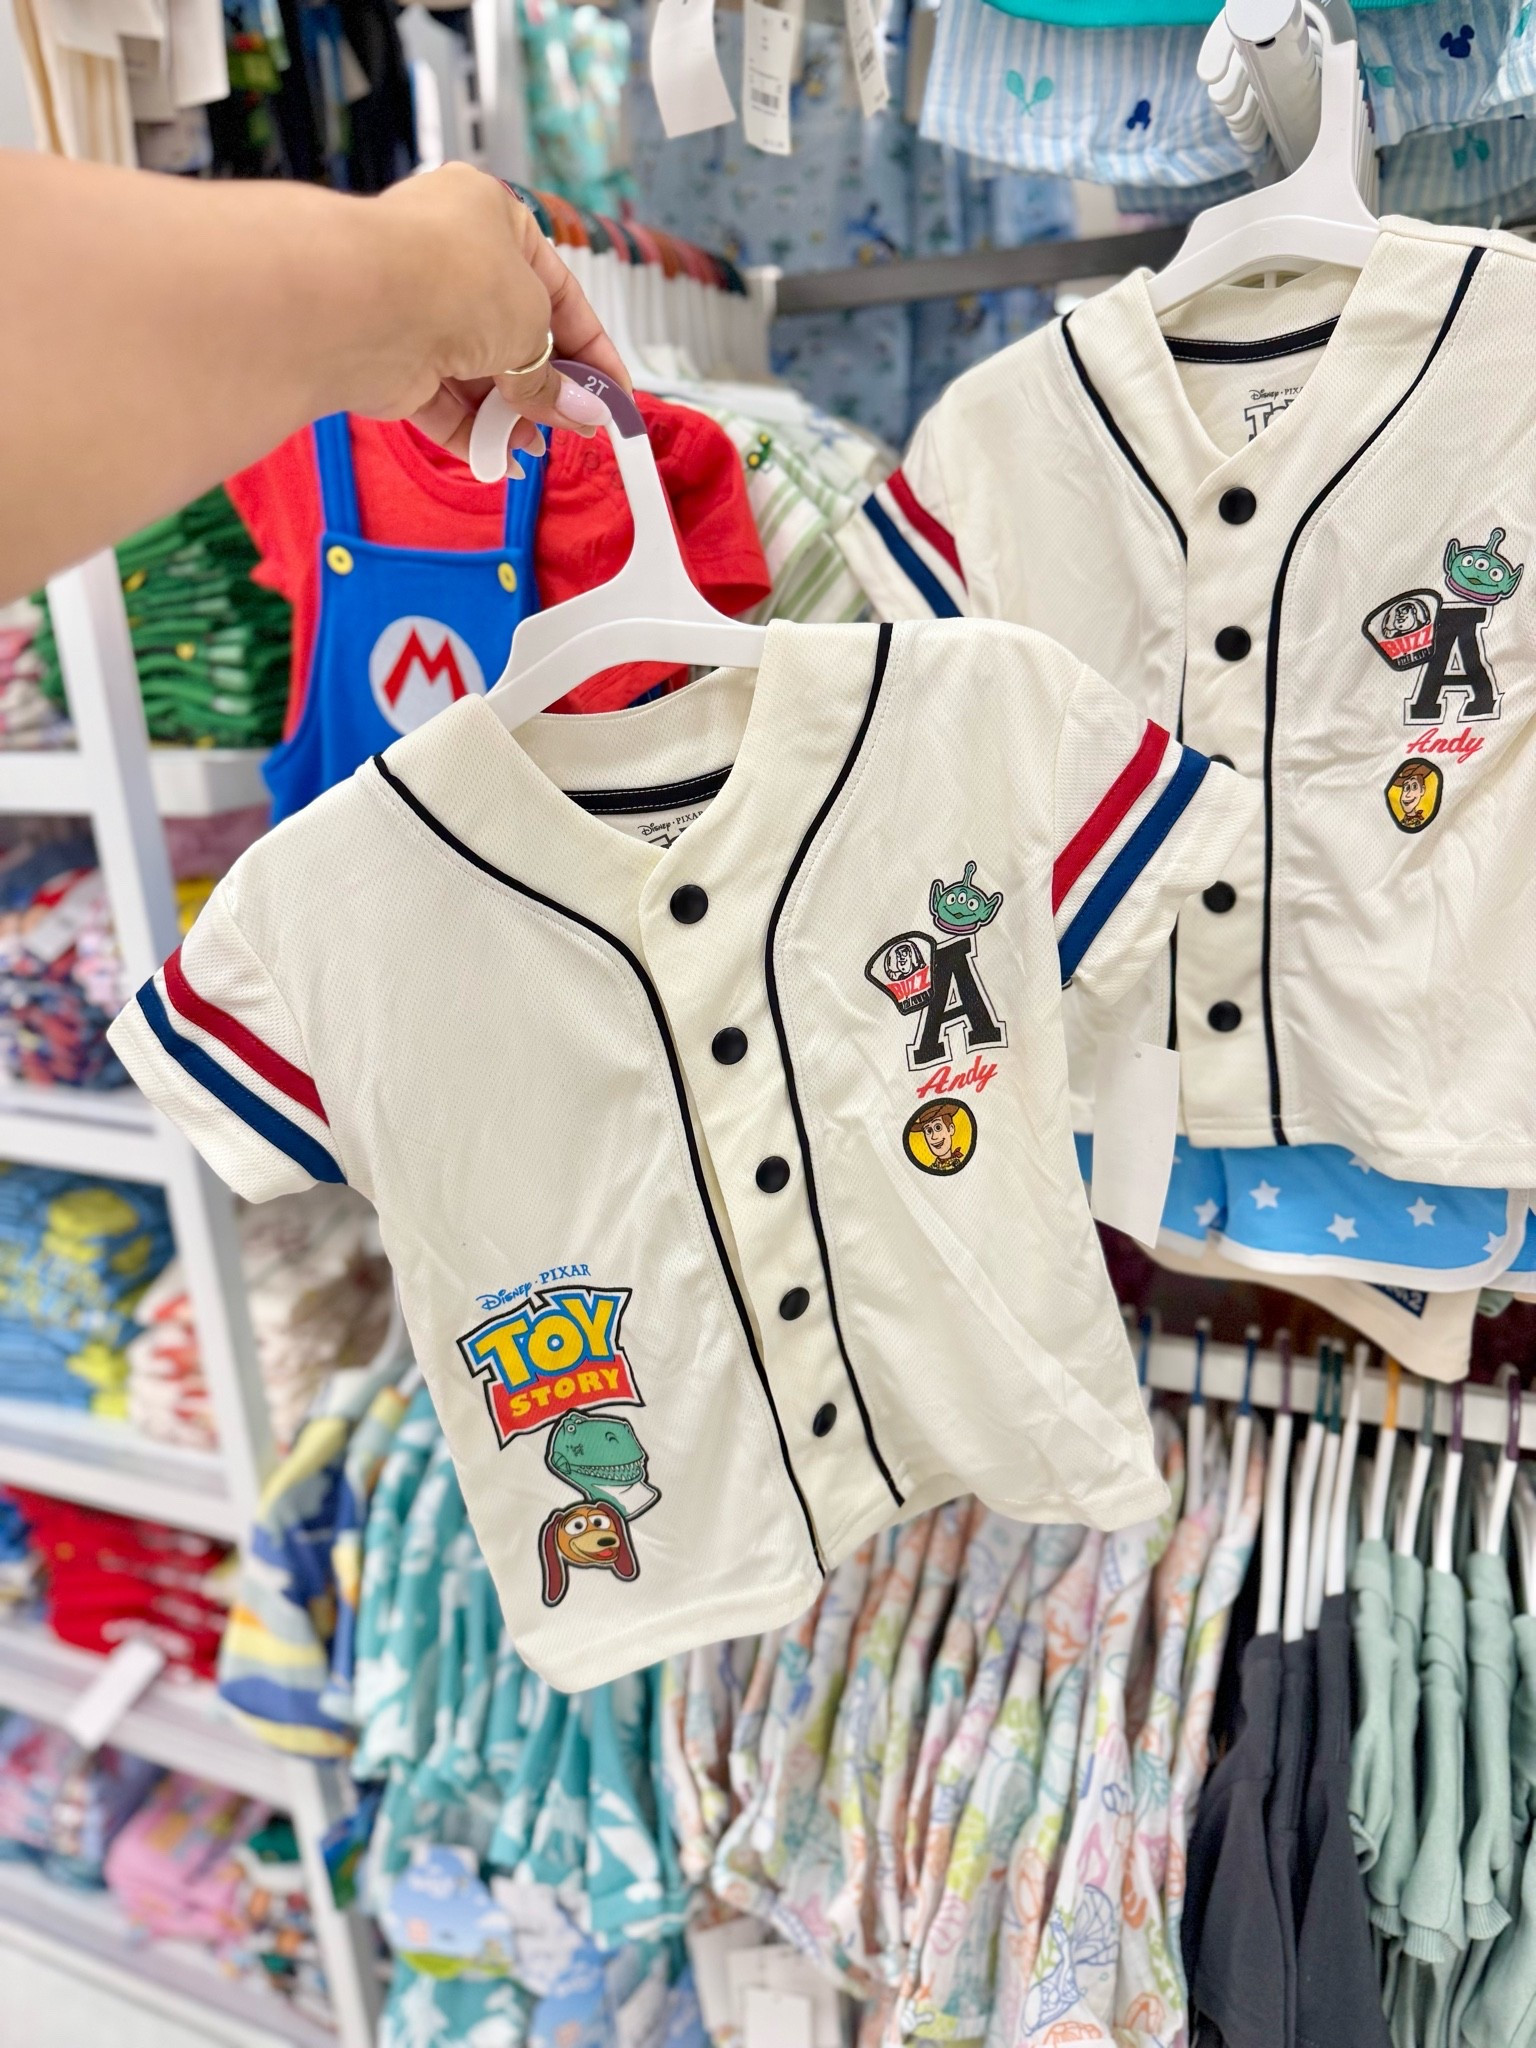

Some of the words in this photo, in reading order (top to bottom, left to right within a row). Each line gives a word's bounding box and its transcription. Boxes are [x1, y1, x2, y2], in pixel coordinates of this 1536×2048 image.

[583, 375, 610, 397] 2T
[1248, 388, 1280, 401] Disney
[1379, 622, 1433, 658] BUZZ
[383, 625, 470, 712] M
[1404, 601, 1504, 725] A
[1406, 727, 1485, 764] Andy
[637, 822, 672, 836] Disney
[886, 965, 931, 1002] BUZZ
[906, 934, 1008, 1071] A
[916, 1055, 998, 1099] Andy
[475, 1281, 533, 1311] Disney
[538, 1263, 592, 1285] PIXAR
[468, 1293, 621, 1393] TOY
[509, 1368, 620, 1418] STORY
